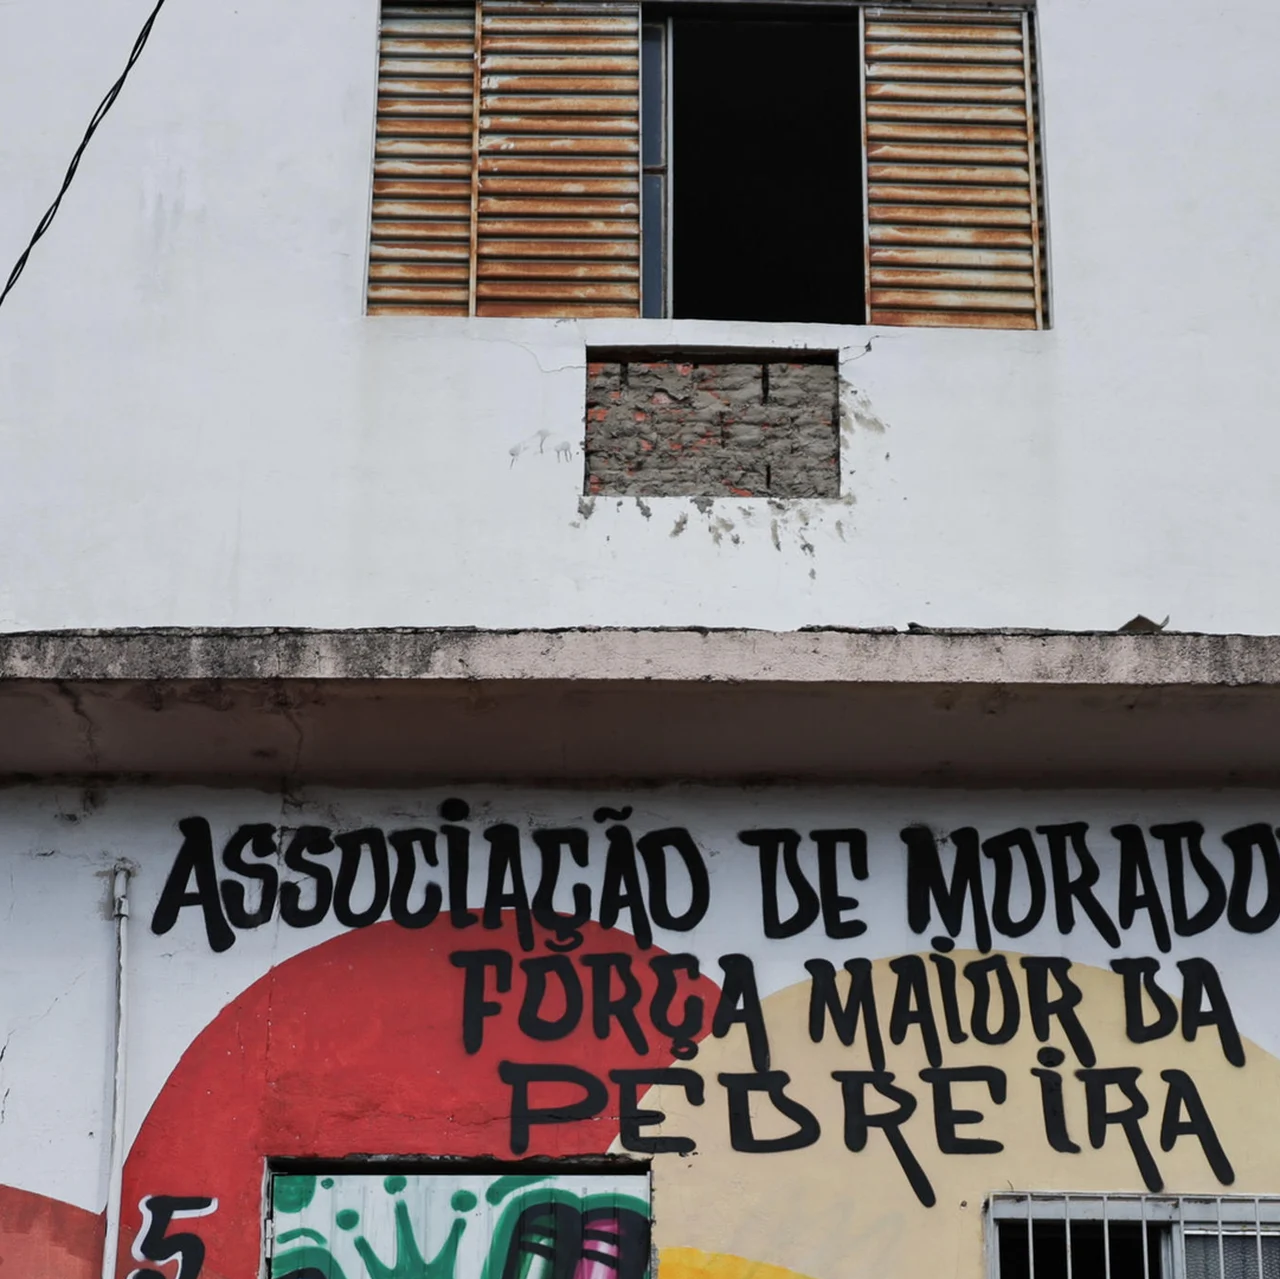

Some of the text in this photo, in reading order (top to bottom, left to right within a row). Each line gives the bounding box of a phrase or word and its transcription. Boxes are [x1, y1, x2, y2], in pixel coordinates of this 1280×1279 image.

[150, 797, 710, 953] ASSOCIAÇÃO
[736, 827, 869, 940] DE
[449, 936, 1246, 1074] FORÇA MAIOR DA
[498, 1045, 1236, 1208] PEDREIRA
